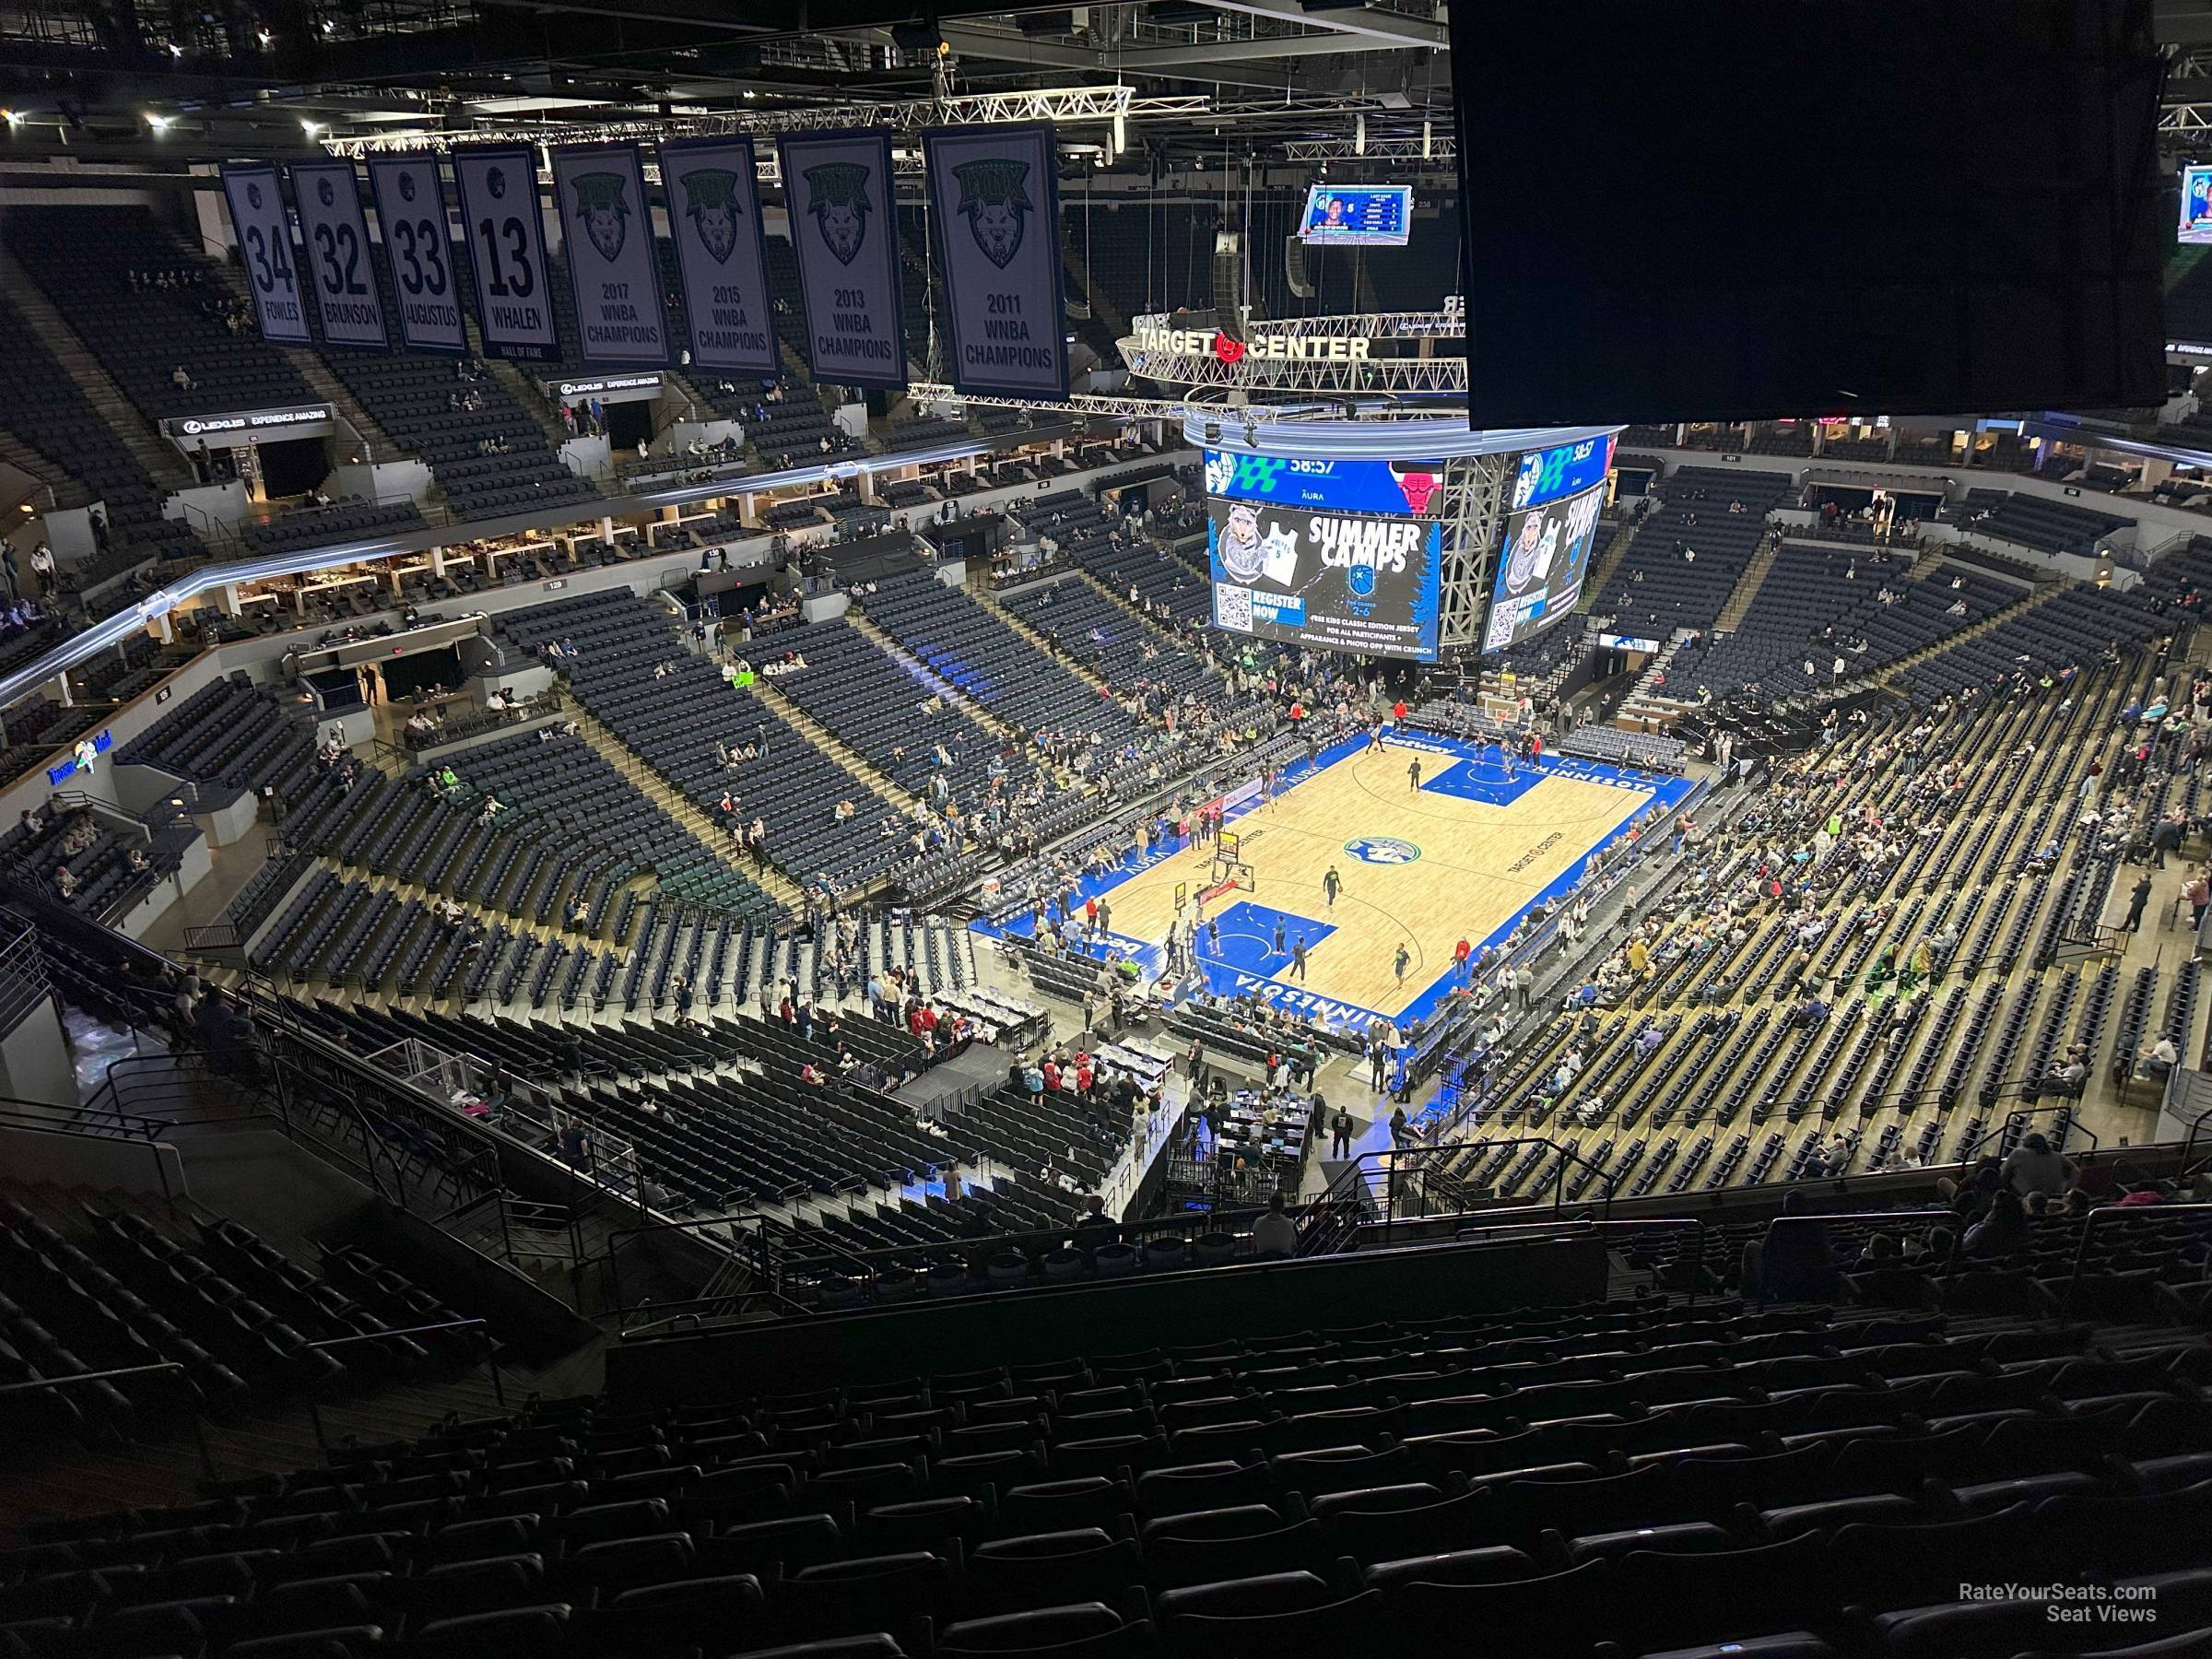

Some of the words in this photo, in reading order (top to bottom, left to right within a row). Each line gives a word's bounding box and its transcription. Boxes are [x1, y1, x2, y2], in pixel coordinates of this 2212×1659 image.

[247, 225, 293, 293] 34
[315, 223, 368, 295] 32
[394, 219, 446, 296] 33
[479, 218, 534, 298] 13
[602, 283, 629, 300] 2017
[712, 286, 740, 304] 2015
[834, 289, 865, 309] 2013
[265, 301, 299, 321] FOWLES
[324, 302, 379, 325] BRUNSON
[600, 305, 638, 322] WNBA
[987, 294, 1021, 315] 2011
[405, 304, 457, 326] AUGUSTUS
[491, 306, 542, 329] WHALEN
[712, 309, 748, 327] WNBA
[832, 313, 872, 334] WNBA
[587, 325, 658, 344] CHAMPIONS
[983, 320, 1030, 341] WNBA
[699, 332, 767, 351] CHAMPIONS
[818, 335, 892, 359] CHAMPIONS
[1139, 327, 1216, 356] TARGET
[1247, 334, 1370, 360] CENTER
[500, 346, 516, 356] HALL
[526, 347, 543, 359] FAME
[966, 345, 1052, 370] CHAMPIONS
[573, 383, 604, 392] LEXUS
[202, 419, 245, 430] LEXUS
[252, 413, 295, 426] EXPERIENCE
[295, 410, 326, 421] AMAZING
[1309, 516, 1421, 551] SUMMER
[1321, 541, 1406, 573] CAMPS
[549, 581, 562, 590] 129
[1253, 591, 1302, 610] REGISTER
[1253, 606, 1279, 619] NOW
[1353, 606, 1371, 617] 2-6
[1311, 615, 1325, 623] FREE
[1342, 618, 1368, 628] CLASSIC
[1368, 622, 1394, 631] EDITION
[1395, 625, 1419, 633] JERSEY
[1327, 627, 1339, 635] FOR
[1352, 629, 1395, 641] PARTICIPANTS
[1300, 633, 1339, 644] APPEARANCE
[1346, 640, 1369, 649] PHOTO
[1384, 643, 1401, 652] WITH
[1403, 646, 1432, 654] CRUNCH
[1381, 735, 1457, 754] betway
[1532, 766, 1658, 794] MINNESOTA
[1507, 854, 1537, 873] TARGET
[1537, 831, 1566, 850] CENTER
